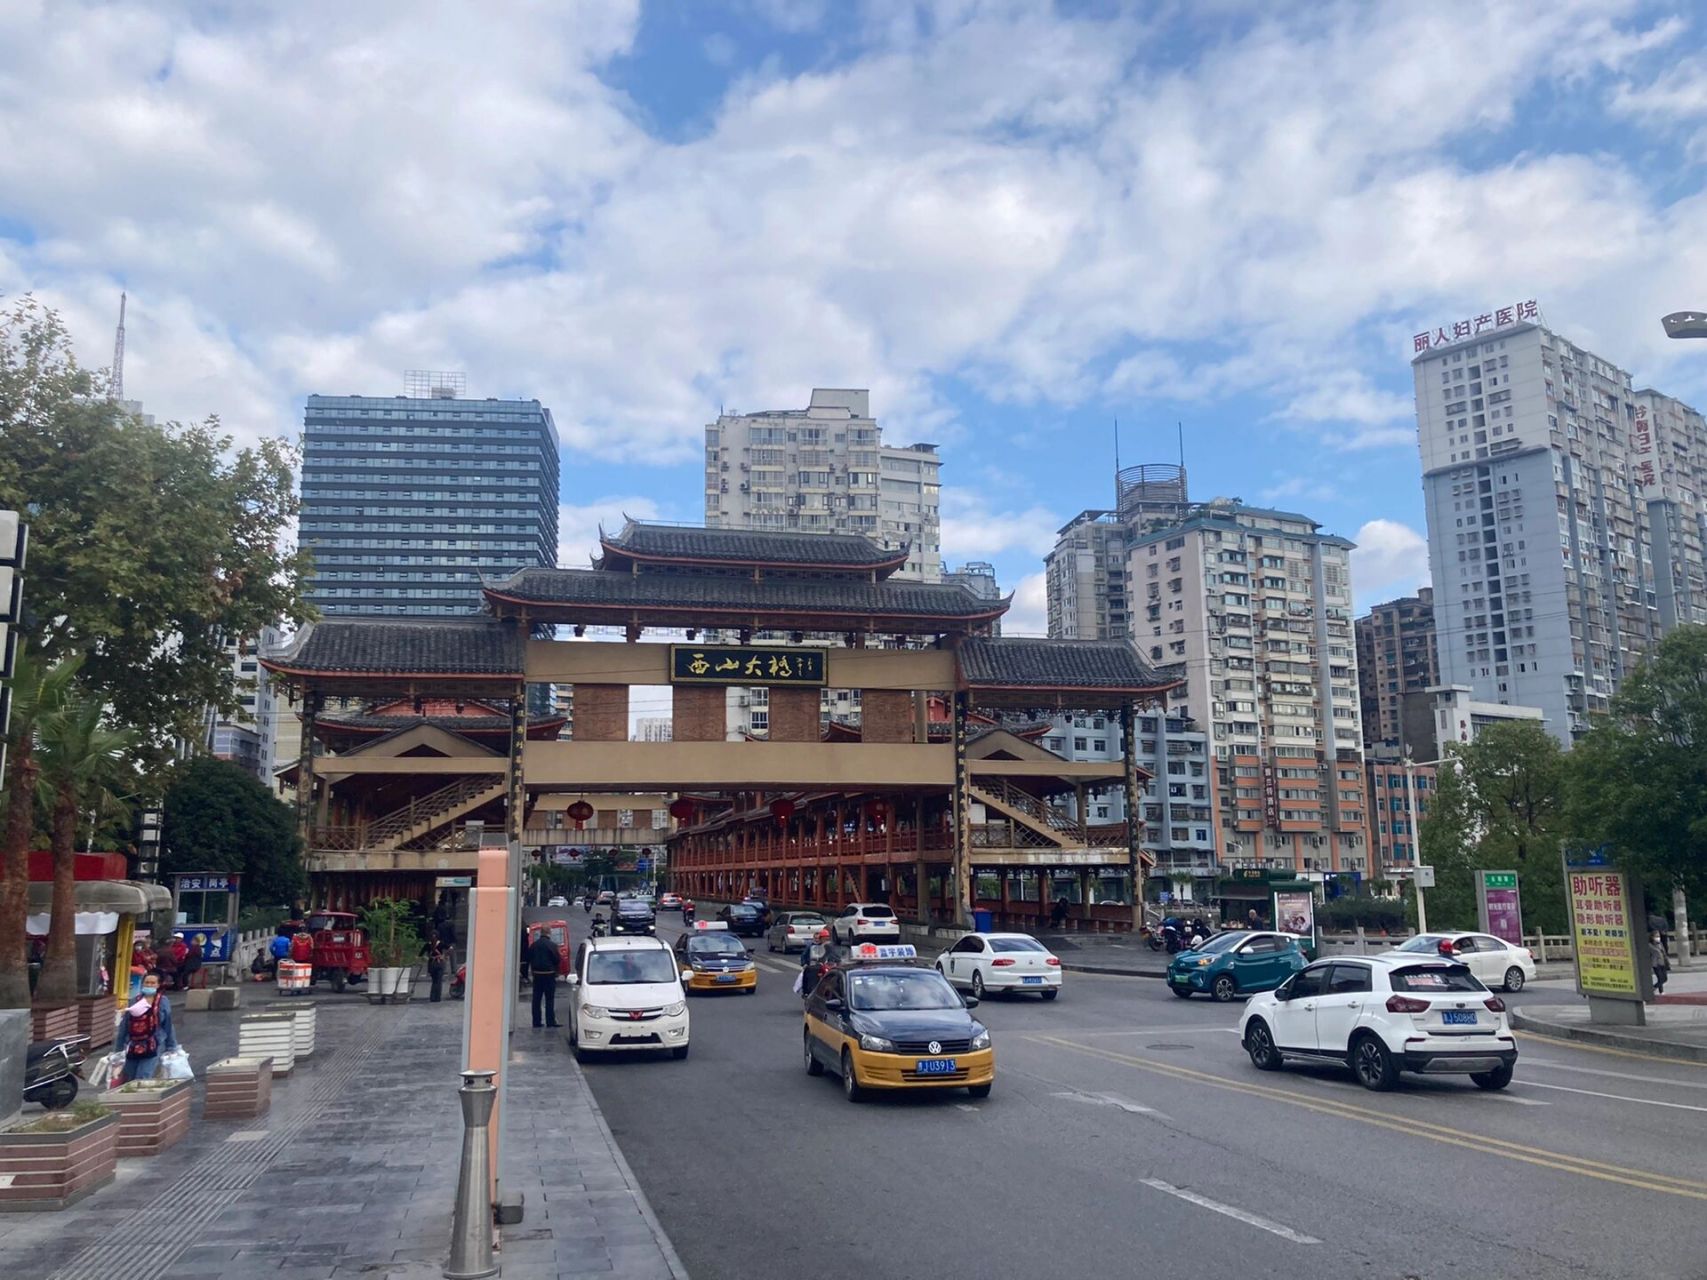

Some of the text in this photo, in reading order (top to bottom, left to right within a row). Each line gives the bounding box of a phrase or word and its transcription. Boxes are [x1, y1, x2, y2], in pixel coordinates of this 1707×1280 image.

[1413, 300, 1538, 352] 丽人妇产医院
[181, 878, 229, 889] 治安岗亭
[1573, 875, 1622, 897] 助听器
[1577, 913, 1624, 926] 隐形助听器
